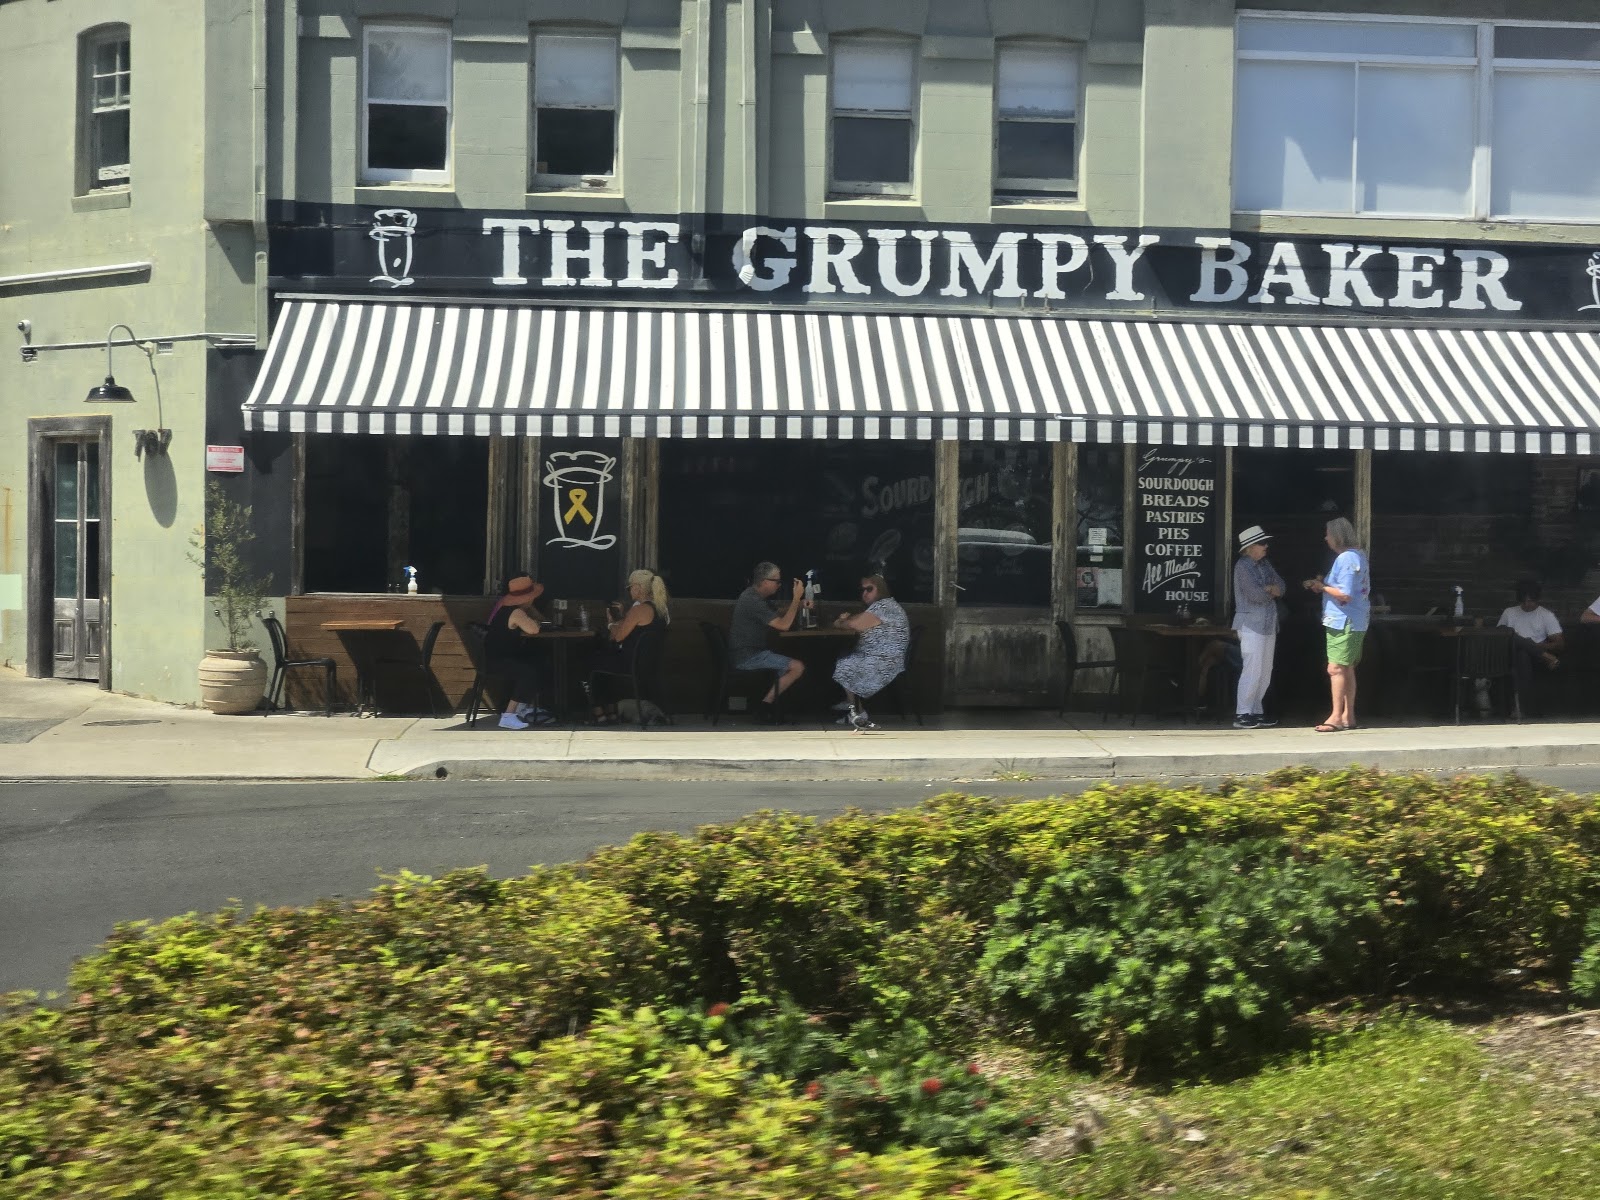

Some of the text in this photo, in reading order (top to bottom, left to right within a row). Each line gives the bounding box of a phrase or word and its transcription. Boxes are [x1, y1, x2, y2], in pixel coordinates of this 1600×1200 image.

[482, 218, 1523, 311] THE GRUMPY BAKER
[1138, 448, 1213, 476] Grumpy's
[1138, 476, 1214, 491] SOURDOUGH
[862, 472, 989, 519] SOURDGH
[1142, 493, 1210, 508] BREADS
[1145, 511, 1205, 524] PASTRIES
[1157, 527, 1190, 540] PIES
[1144, 543, 1203, 557] COFFEE
[1142, 557, 1198, 594] All Made
[1180, 578, 1196, 589] IN
[1165, 590, 1209, 602] HOUSE
